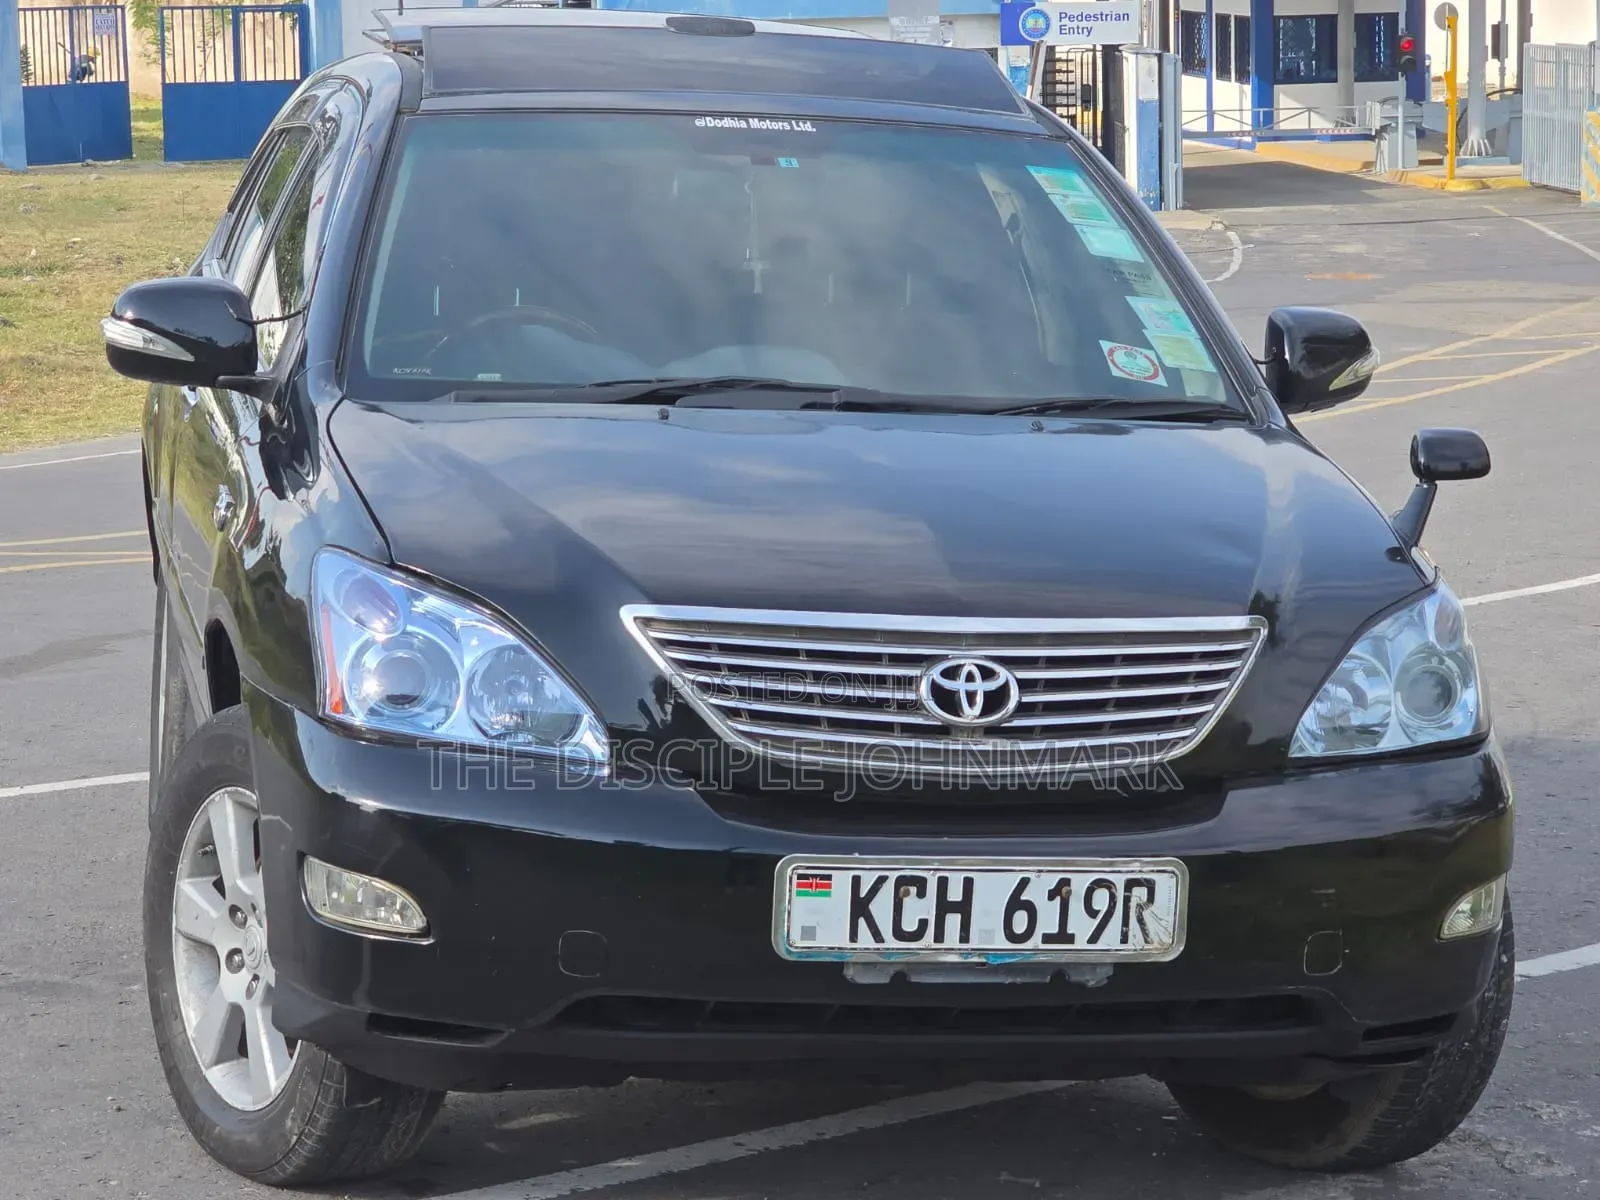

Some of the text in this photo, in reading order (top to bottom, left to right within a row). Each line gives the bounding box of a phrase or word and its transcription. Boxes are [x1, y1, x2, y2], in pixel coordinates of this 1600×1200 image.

[1058, 11, 1130, 23] Pedestrian
[1058, 24, 1093, 36] Entry
[748, 118, 791, 131] Motors
[791, 120, 817, 132] Ltd.
[848, 873, 1158, 945] KCH 619R
